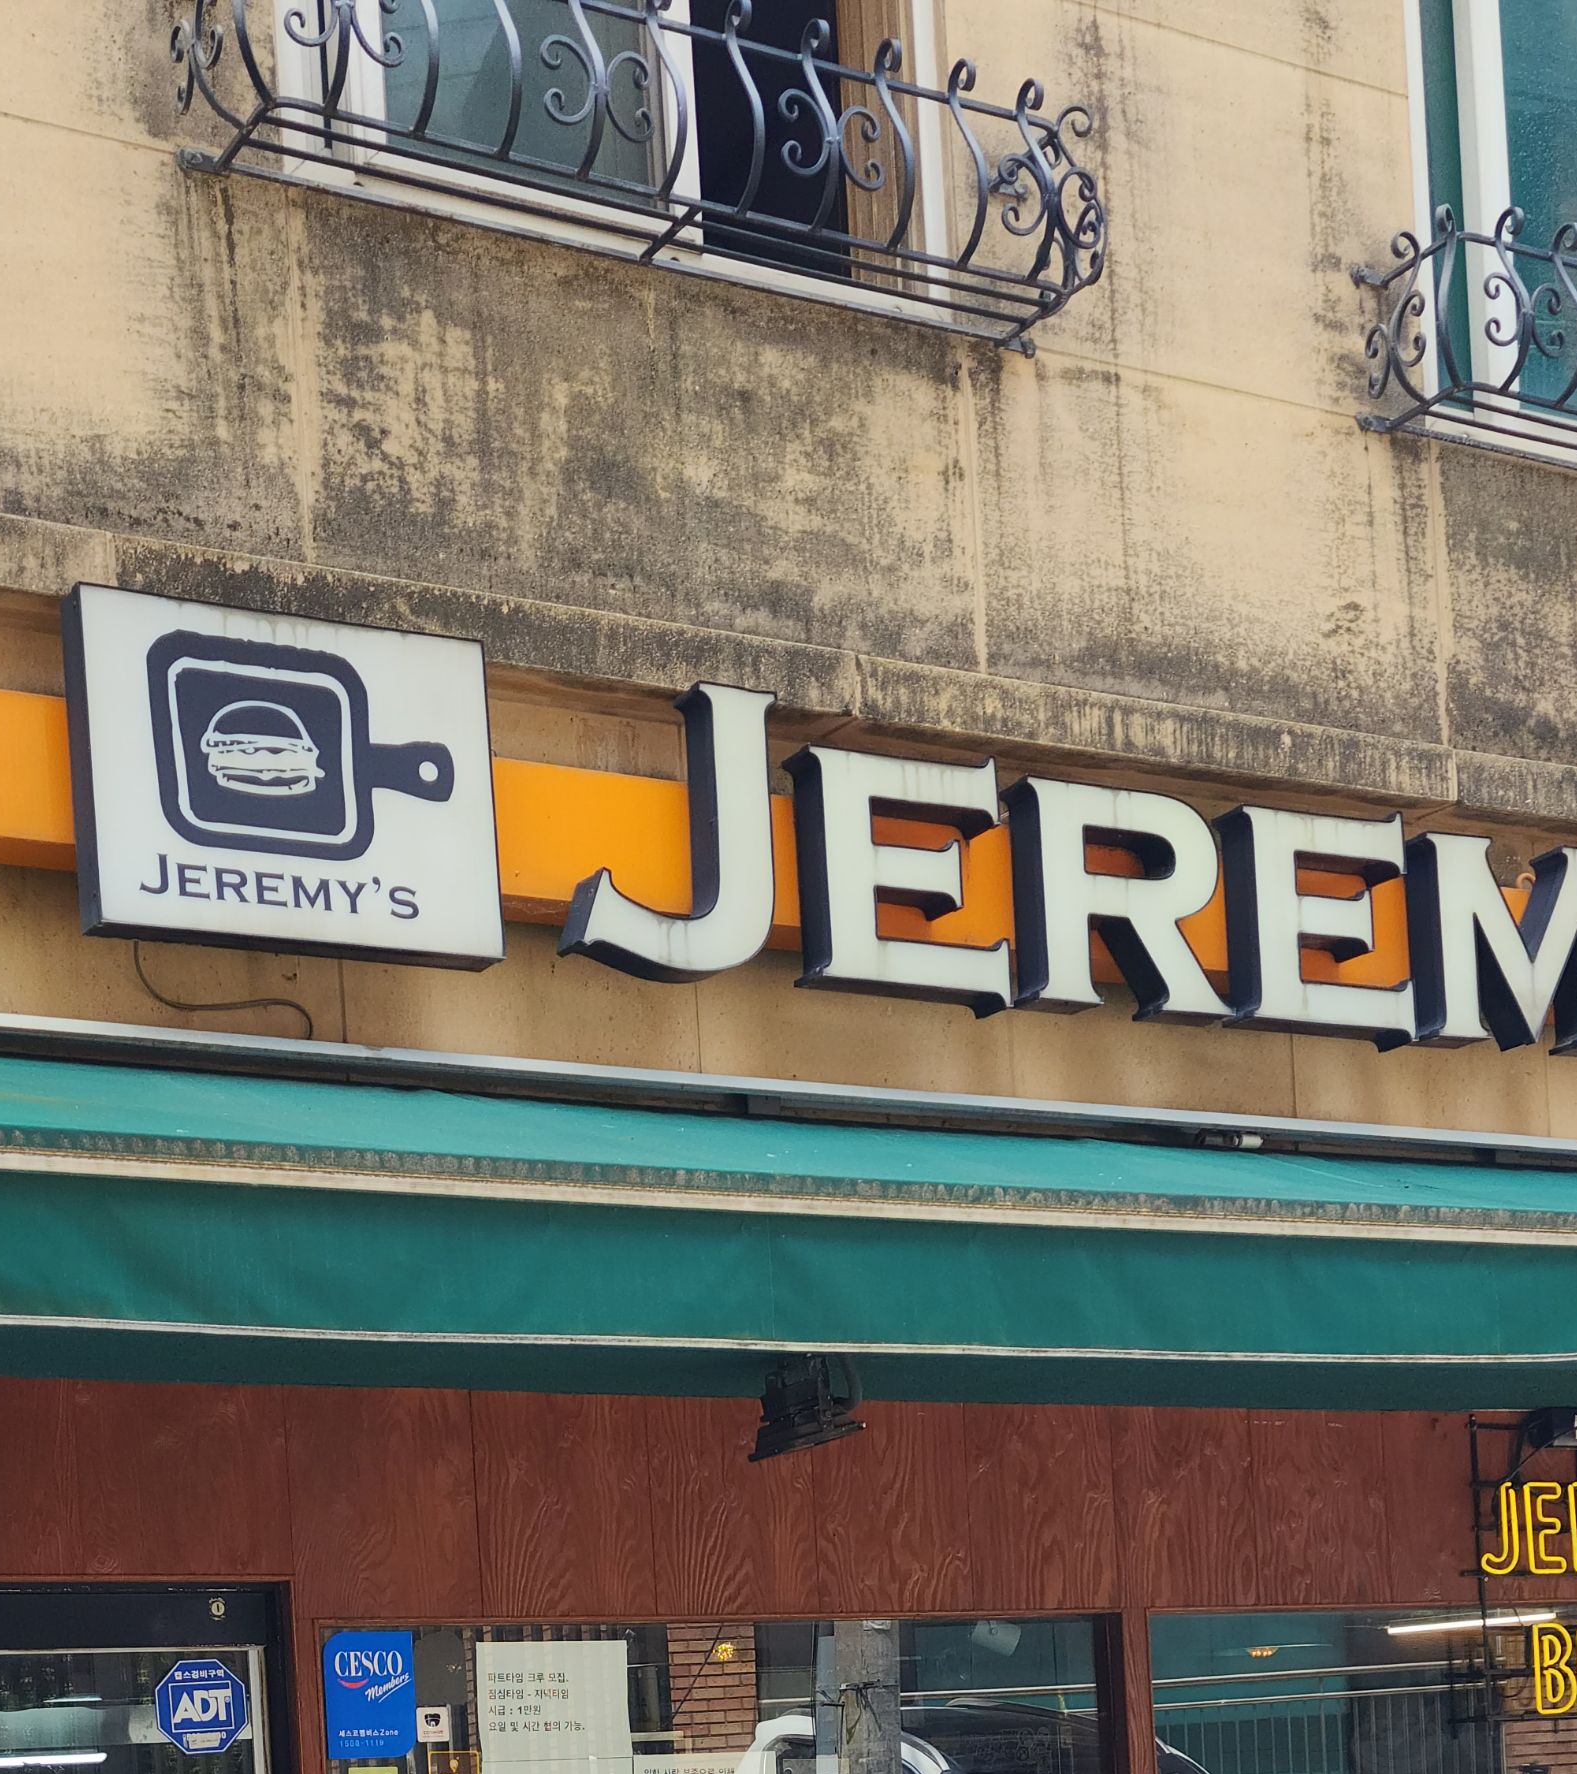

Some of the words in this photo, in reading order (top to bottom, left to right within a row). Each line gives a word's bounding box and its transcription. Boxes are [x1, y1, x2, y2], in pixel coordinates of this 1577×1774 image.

[139, 853, 420, 920] JEREMY'S
[334, 1650, 403, 1677] CESCO
[365, 1672, 410, 1702] Members
[487, 1672, 524, 1684] 파트타임
[528, 1672, 544, 1684] 크루
[548, 1672, 569, 1684] 모집.
[488, 1689, 524, 1700] 점심타임
[534, 1688, 569, 1700] 저녁타임
[173, 1688, 232, 1724] ADT
[488, 1705, 506, 1716] 시급
[517, 1705, 541, 1716] 1만원
[489, 1721, 506, 1733] 요일
[510, 1721, 518, 1732] 및
[523, 1720, 540, 1732] 시간
[543, 1720, 561, 1732] 협의
[564, 1720, 585, 1732] 가능.
